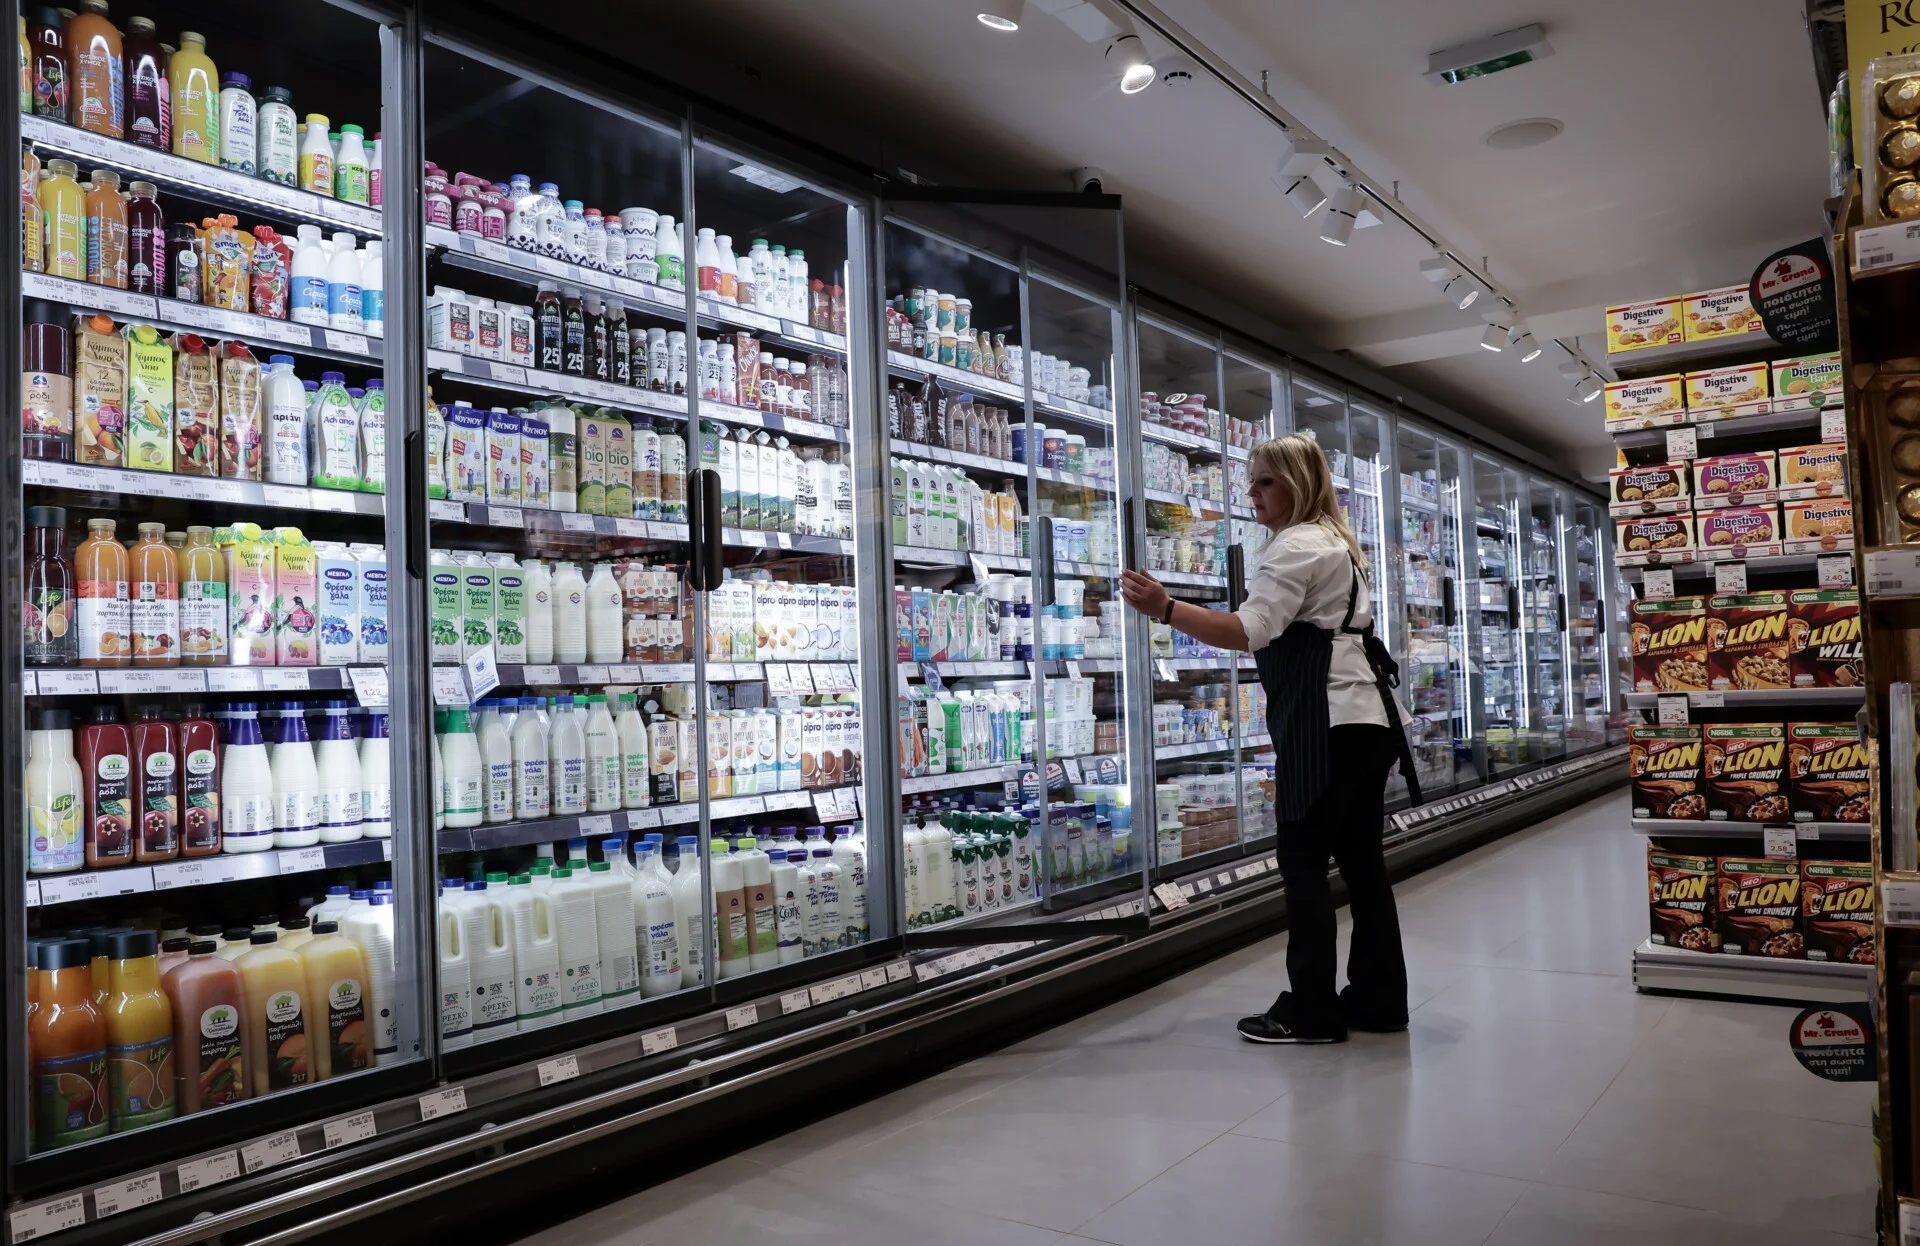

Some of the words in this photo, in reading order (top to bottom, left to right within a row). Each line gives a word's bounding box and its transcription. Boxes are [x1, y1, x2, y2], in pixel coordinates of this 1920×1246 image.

[1762, 280, 1779, 289] Mr.
[1781, 266, 1814, 282] Grand
[1701, 295, 1743, 308] Digestive
[1764, 284, 1821, 309] ποιότητα
[1623, 307, 1663, 320] Digestive
[1769, 305, 1786, 316] στη
[1784, 306, 1810, 320] τιμή!
[543, 347, 560, 365] 25
[568, 353, 583, 371] 25
[1792, 363, 1841, 377] Digestive
[1704, 374, 1747, 387] Digestive
[1810, 373, 1827, 383] Bar
[1622, 386, 1662, 398] Digestive
[585, 447, 603, 462] bio
[608, 451, 629, 465] bio
[1799, 454, 1842, 465] Digestiv
[1711, 464, 1758, 476] Digestive
[1625, 473, 1669, 484] Digestive
[1729, 474, 1745, 482] Bar
[1643, 482, 1658, 491] Bar
[1715, 515, 1761, 527] Digestive
[1823, 518, 1840, 526] Bar
[1633, 523, 1677, 535] Digestive
[1732, 526, 1749, 534] Bar
[1650, 533, 1665, 541] Bar
[325, 583, 353, 594] Φρέσκο
[433, 588, 458, 598] Φρέσκο
[466, 588, 491, 598] Φρέσκο
[500, 589, 523, 599] Φρέσκο
[757, 594, 775, 606] alpro
[778, 596, 796, 607] alpro
[798, 597, 816, 608] alpro
[821, 598, 839, 609] alpro
[1650, 617, 1706, 648] LION
[1726, 613, 1788, 646] LION
[804, 722, 821, 732] alpro
[825, 721, 842, 731] alpro
[843, 720, 859, 729] alpro
[1646, 743, 1701, 772] LION
[1724, 742, 1784, 773] LION
[1668, 769, 1699, 779] CRUNCHY
[1749, 769, 1783, 779] CRUNCHY
[1661, 876, 1707, 900] LION
[1738, 879, 1799, 906] LION
[1680, 901, 1706, 911] CRUNCHY
[1762, 907, 1798, 916] CRUNCHY
[481, 1001, 512, 1012] ΦΡΕΣΚΟ
[442, 1011, 468, 1022] ΡΕΣΚΟ
[1804, 1030, 1821, 1038] Mr.
[1824, 1028, 1859, 1037] Grand
[1825, 1066, 1851, 1076] τιμή!
